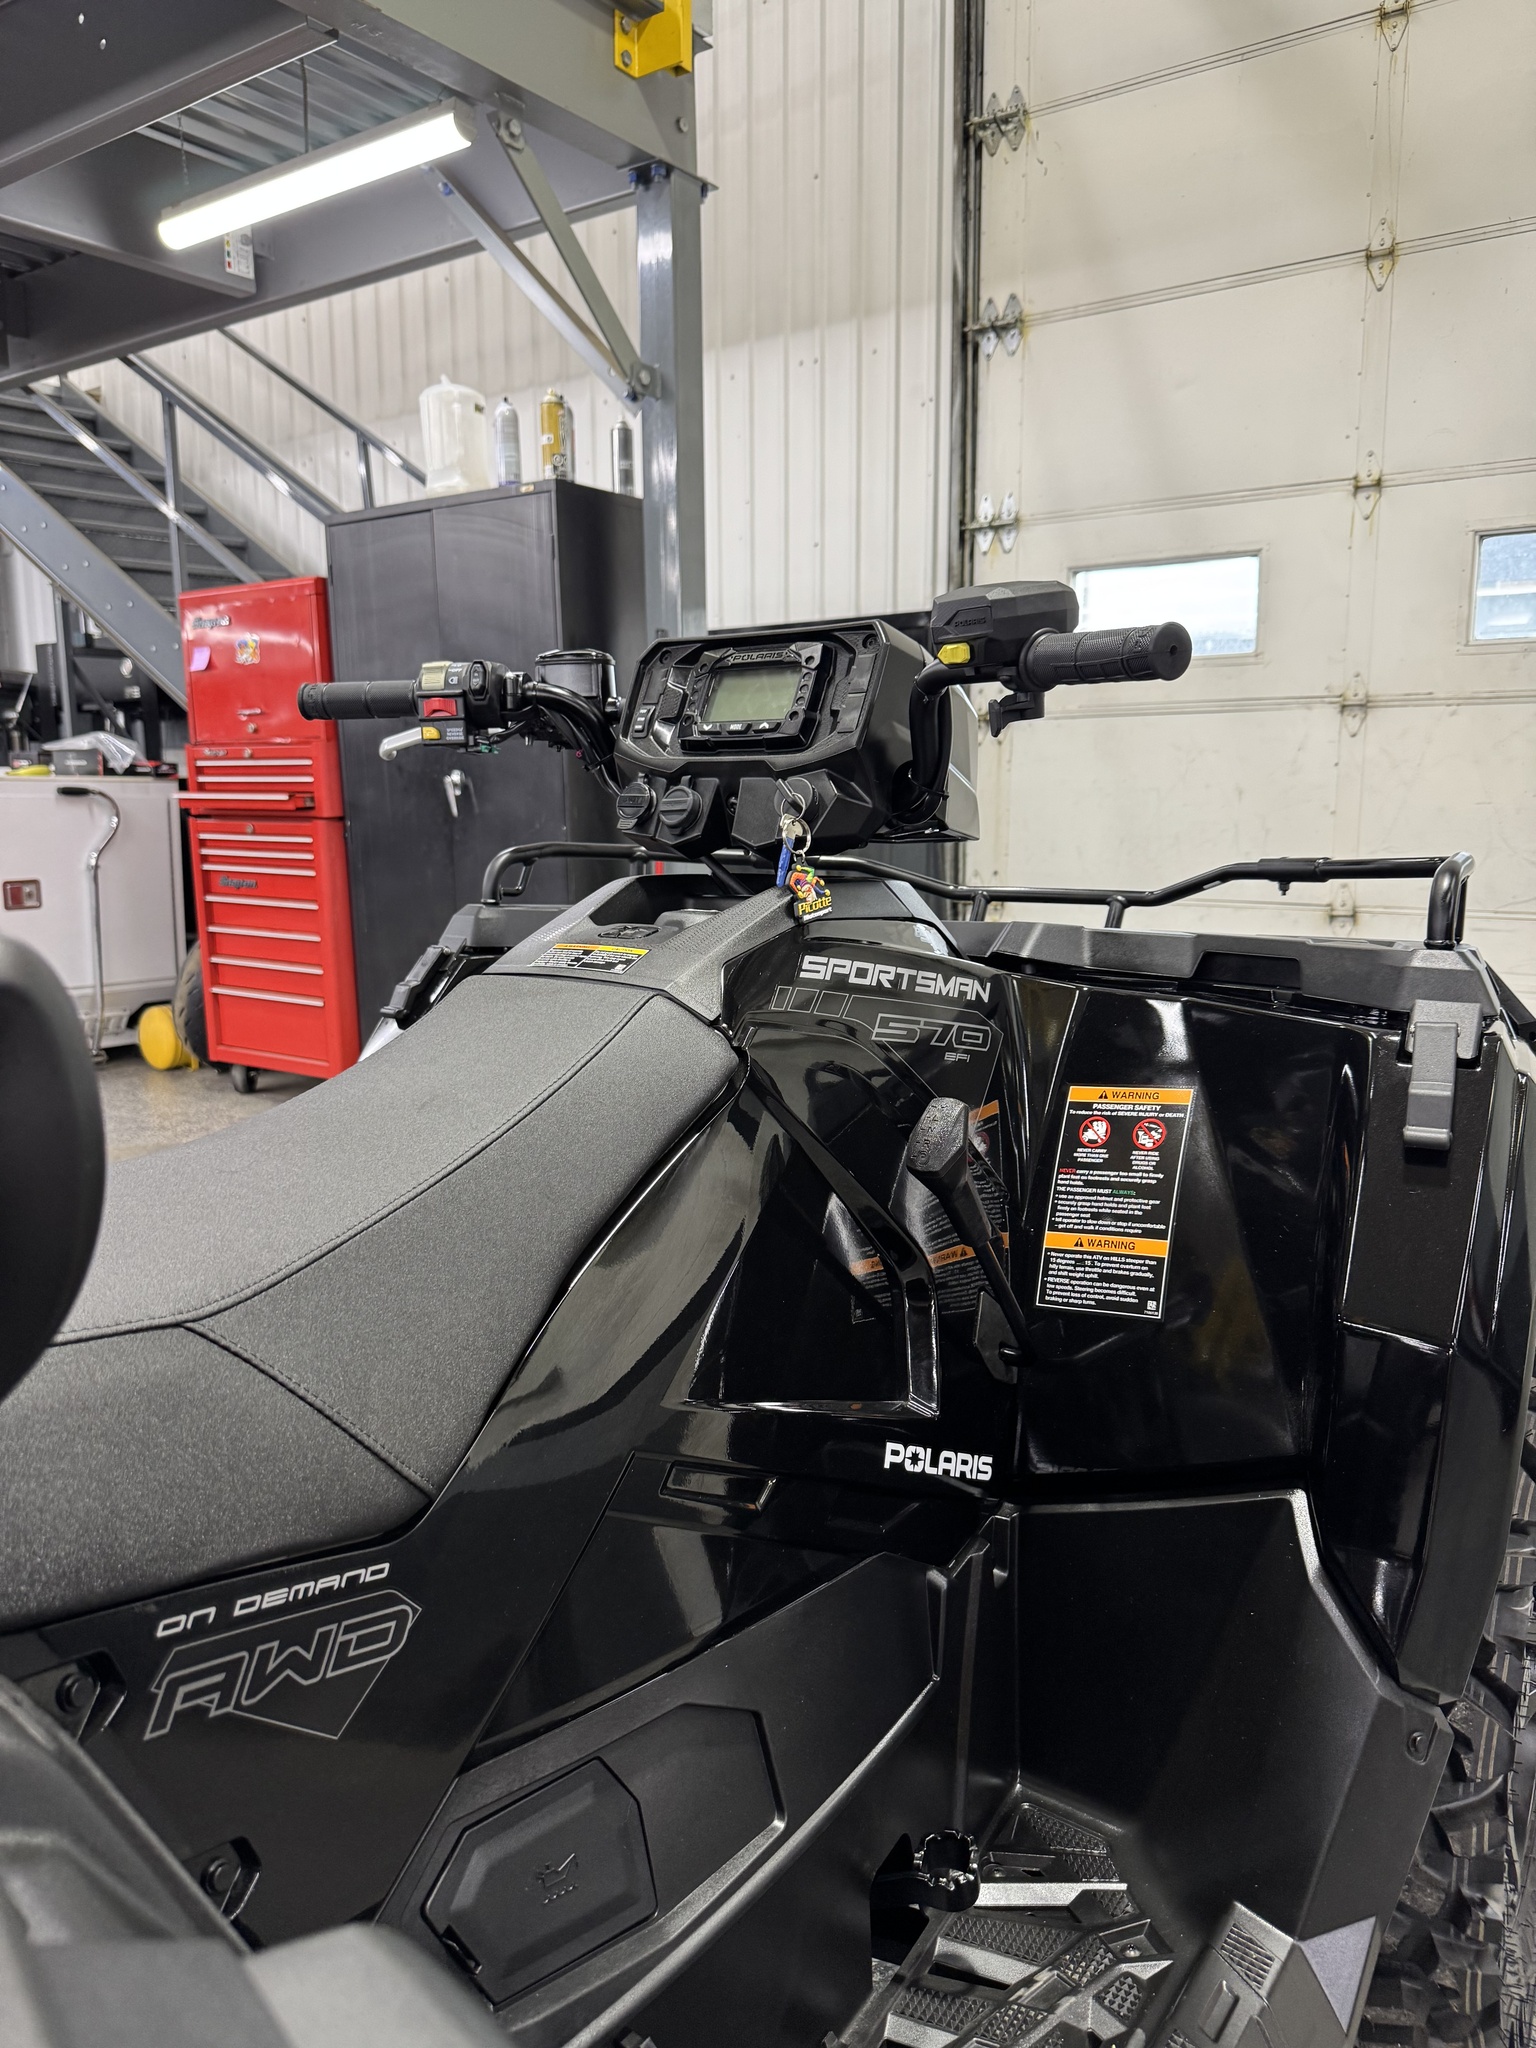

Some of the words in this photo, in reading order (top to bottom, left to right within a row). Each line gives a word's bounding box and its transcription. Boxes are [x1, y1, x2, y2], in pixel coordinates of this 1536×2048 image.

[953, 616, 987, 628] POLARIS
[733, 651, 784, 662] POLARIS
[798, 954, 991, 1003] SPORTSMAN
[871, 1012, 992, 1051] 570
[944, 1052, 970, 1063] EFI
[1112, 1091, 1159, 1100] WARNING
[1087, 1239, 1135, 1250] WARNING
[883, 1441, 993, 1482] POLARIS
[155, 1606, 217, 1638] ON
[233, 1562, 391, 1617] DEMAND
[142, 1604, 414, 1741] AWD
